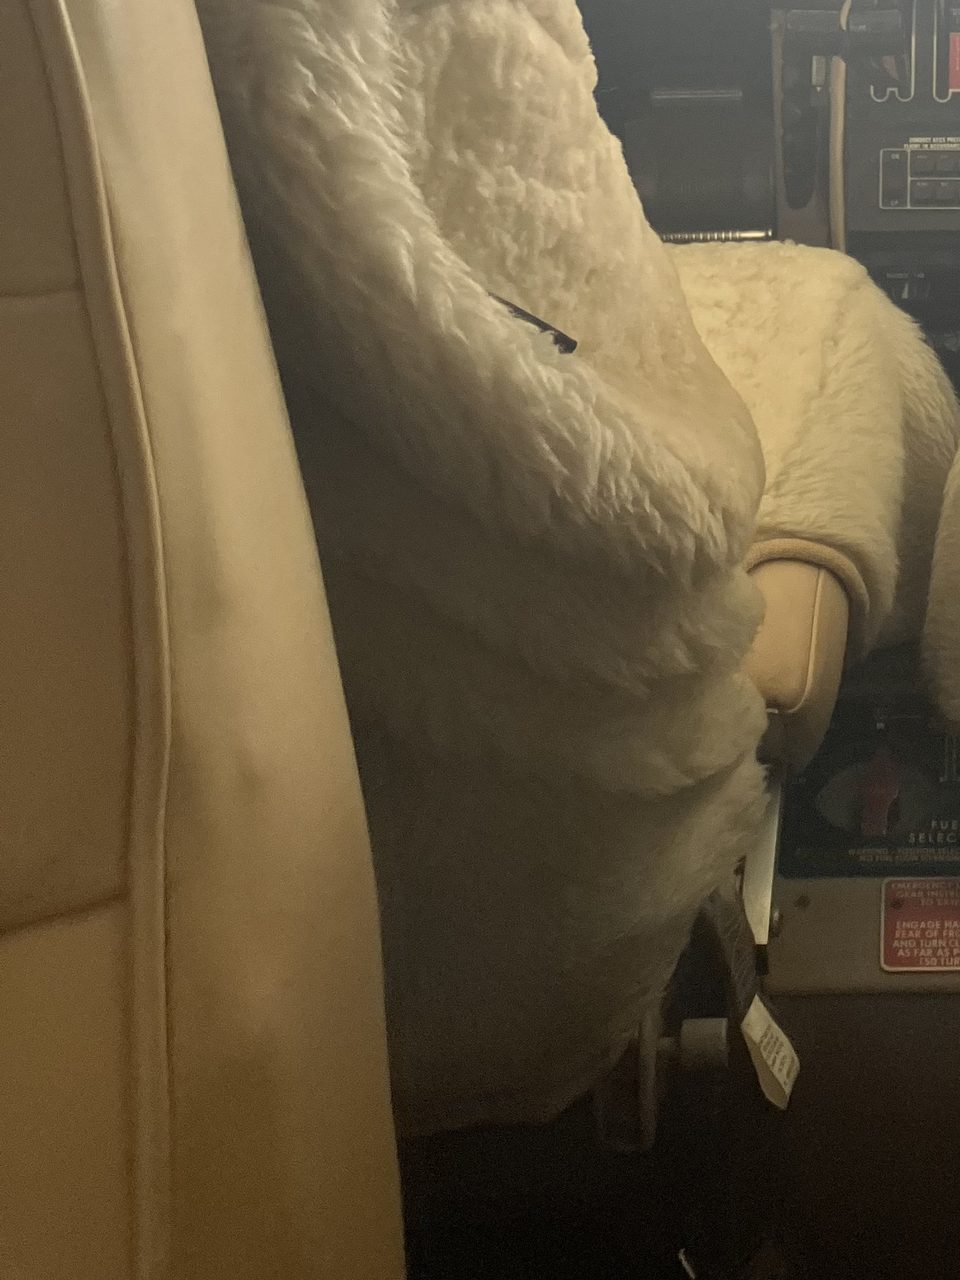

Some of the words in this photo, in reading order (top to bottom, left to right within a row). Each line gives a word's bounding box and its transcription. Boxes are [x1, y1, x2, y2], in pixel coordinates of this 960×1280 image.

[896, 920, 941, 929] ENGAGE
[895, 929, 921, 938] REAR
[925, 929, 938, 938] OF
[893, 939, 916, 948] AND
[920, 938, 946, 948] TURN
[897, 948, 911, 957] AS
[914, 948, 933, 957] FAR
